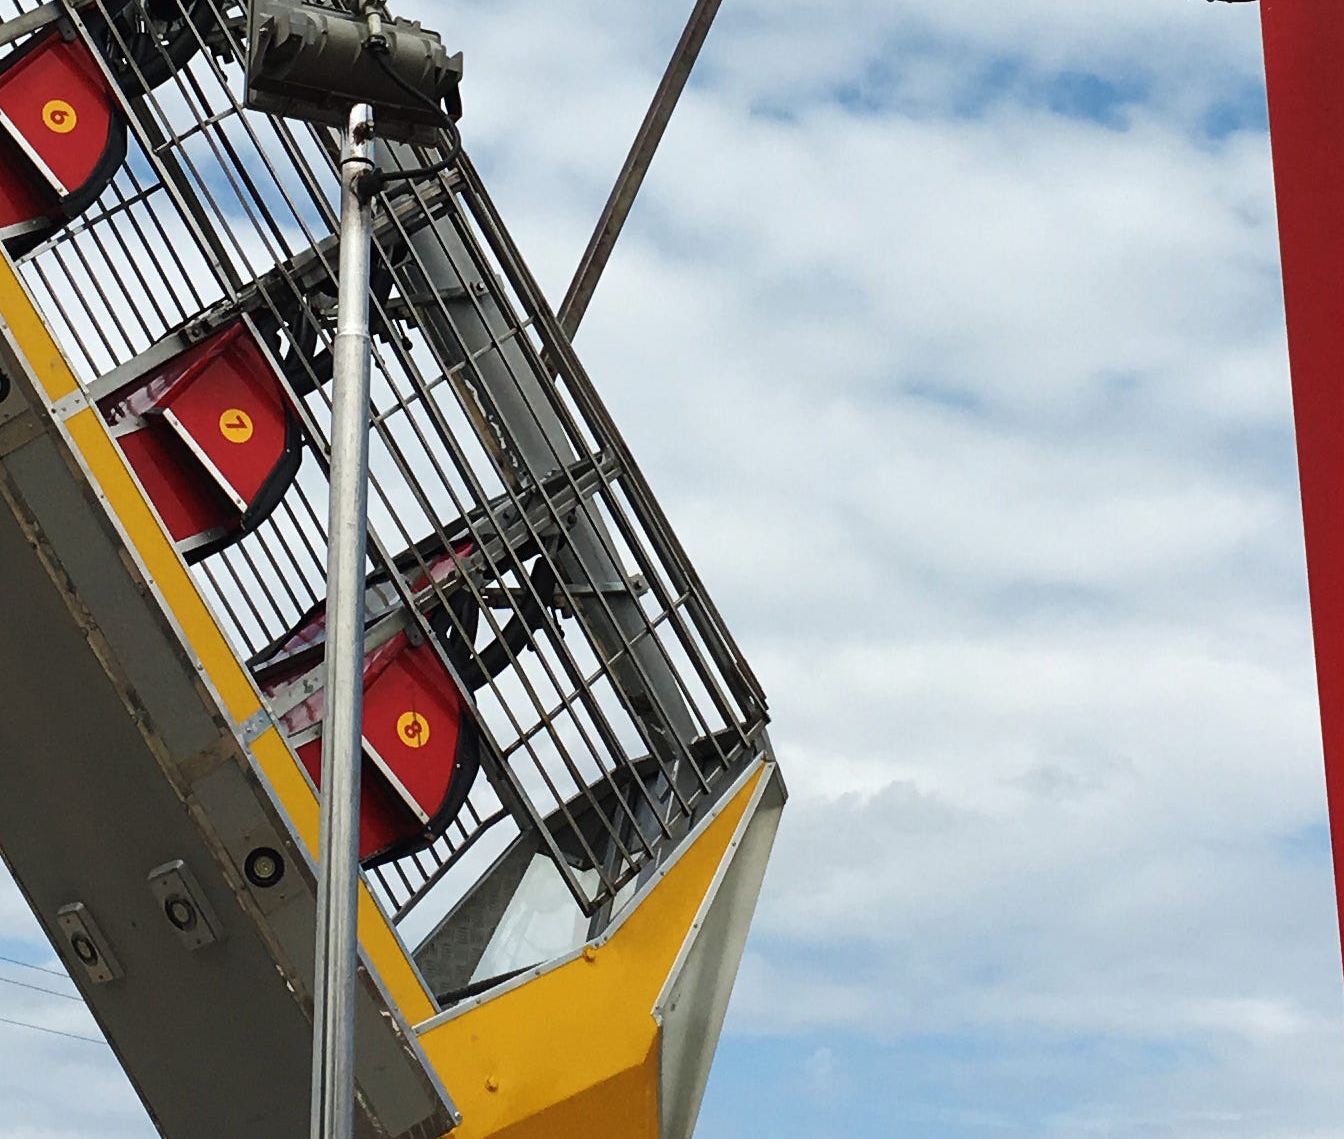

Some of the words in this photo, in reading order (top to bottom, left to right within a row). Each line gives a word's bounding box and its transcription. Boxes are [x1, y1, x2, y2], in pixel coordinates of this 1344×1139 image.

[48, 109, 70, 126] 6
[225, 415, 248, 431] 7
[403, 719, 424, 739] 8
